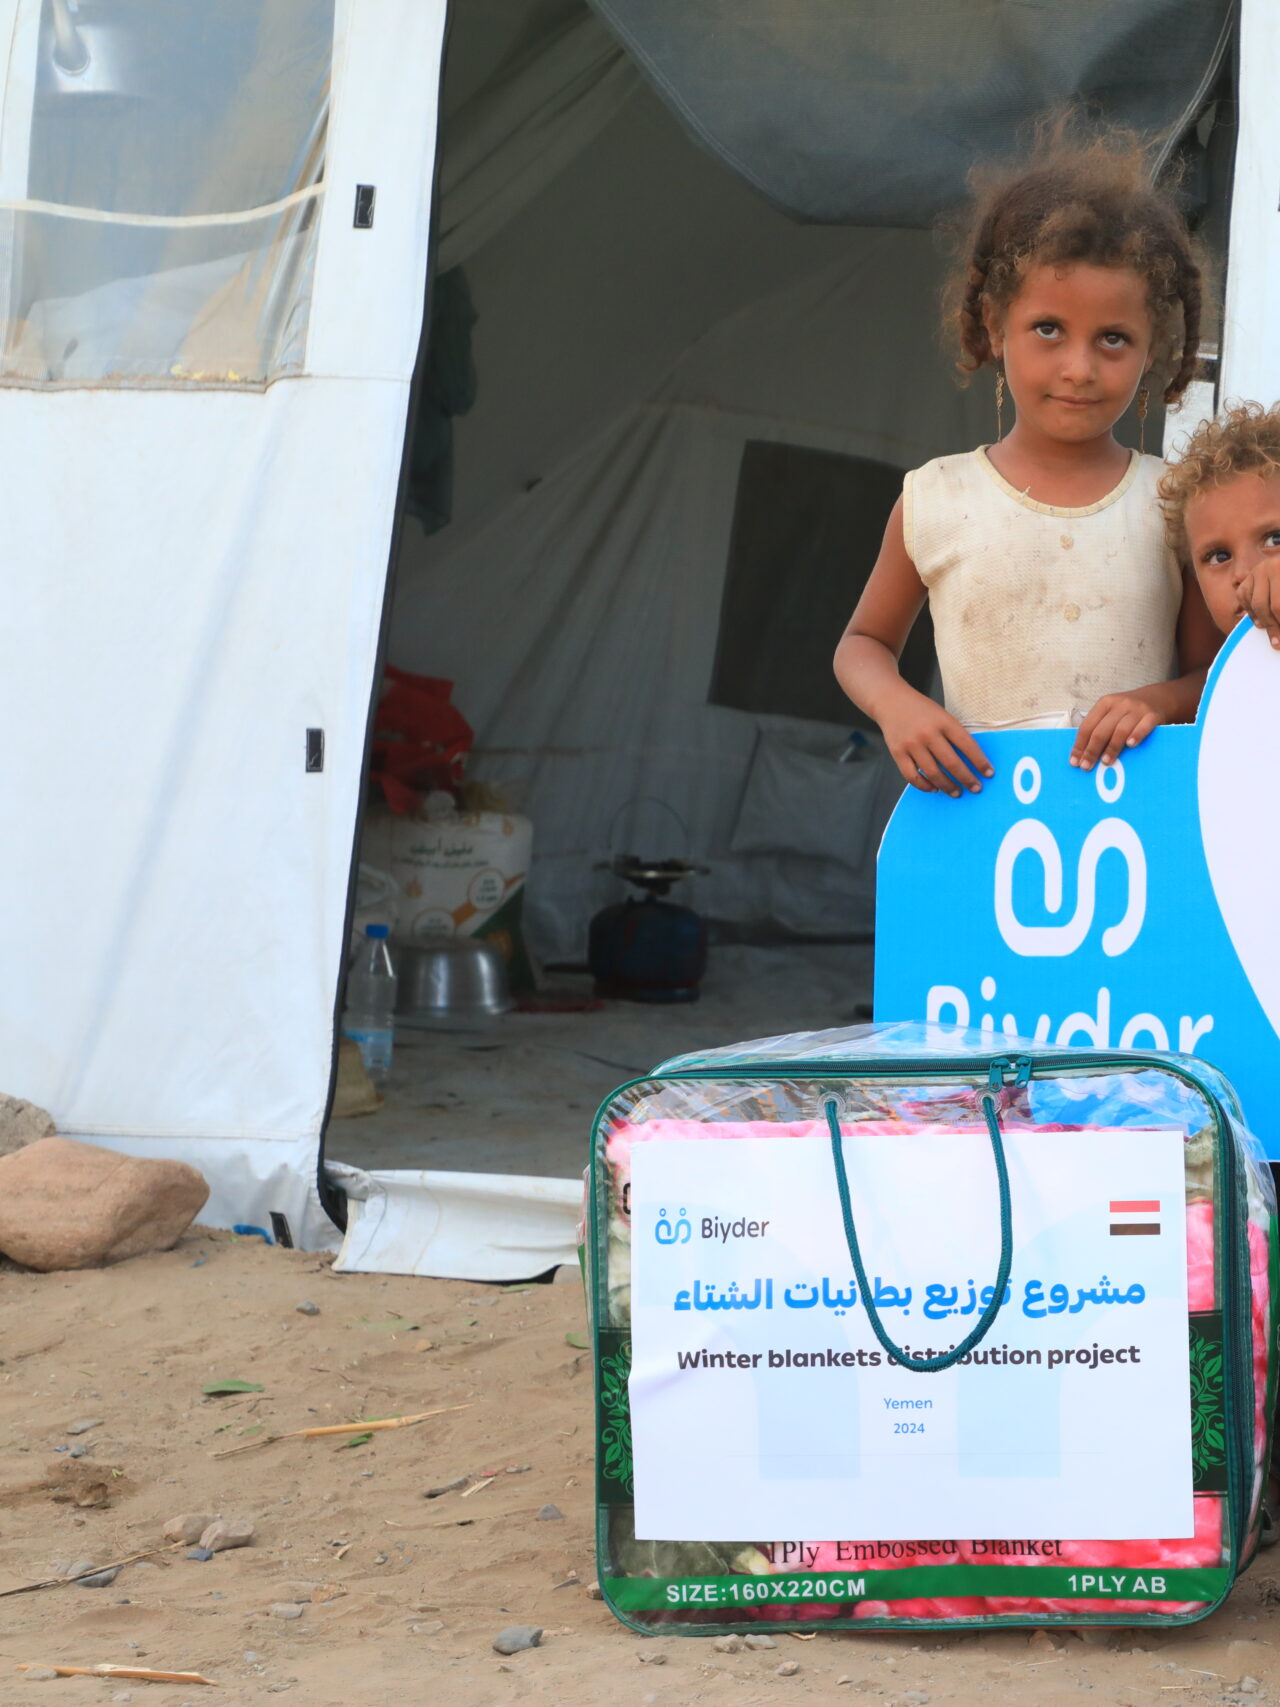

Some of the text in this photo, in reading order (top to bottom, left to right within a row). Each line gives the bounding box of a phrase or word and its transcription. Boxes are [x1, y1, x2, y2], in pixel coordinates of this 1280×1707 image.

[701, 1216, 769, 1244] Biyder
[674, 1279, 774, 1312] الشتاء
[783, 1276, 913, 1317] بطنيات
[1022, 1276, 1147, 1319] مشروع
[677, 1349, 763, 1370] Winter
[768, 1348, 882, 1368] blankets
[1047, 1344, 1141, 1369] project
[884, 1397, 933, 1410] Yemen
[893, 1422, 925, 1435] 2024
[835, 1540, 957, 1562] Embossed
[970, 1540, 1063, 1556] Blanket
[666, 1578, 866, 1603] SIZE:160X220CM
[1067, 1575, 1166, 1594] 1PLY AB
